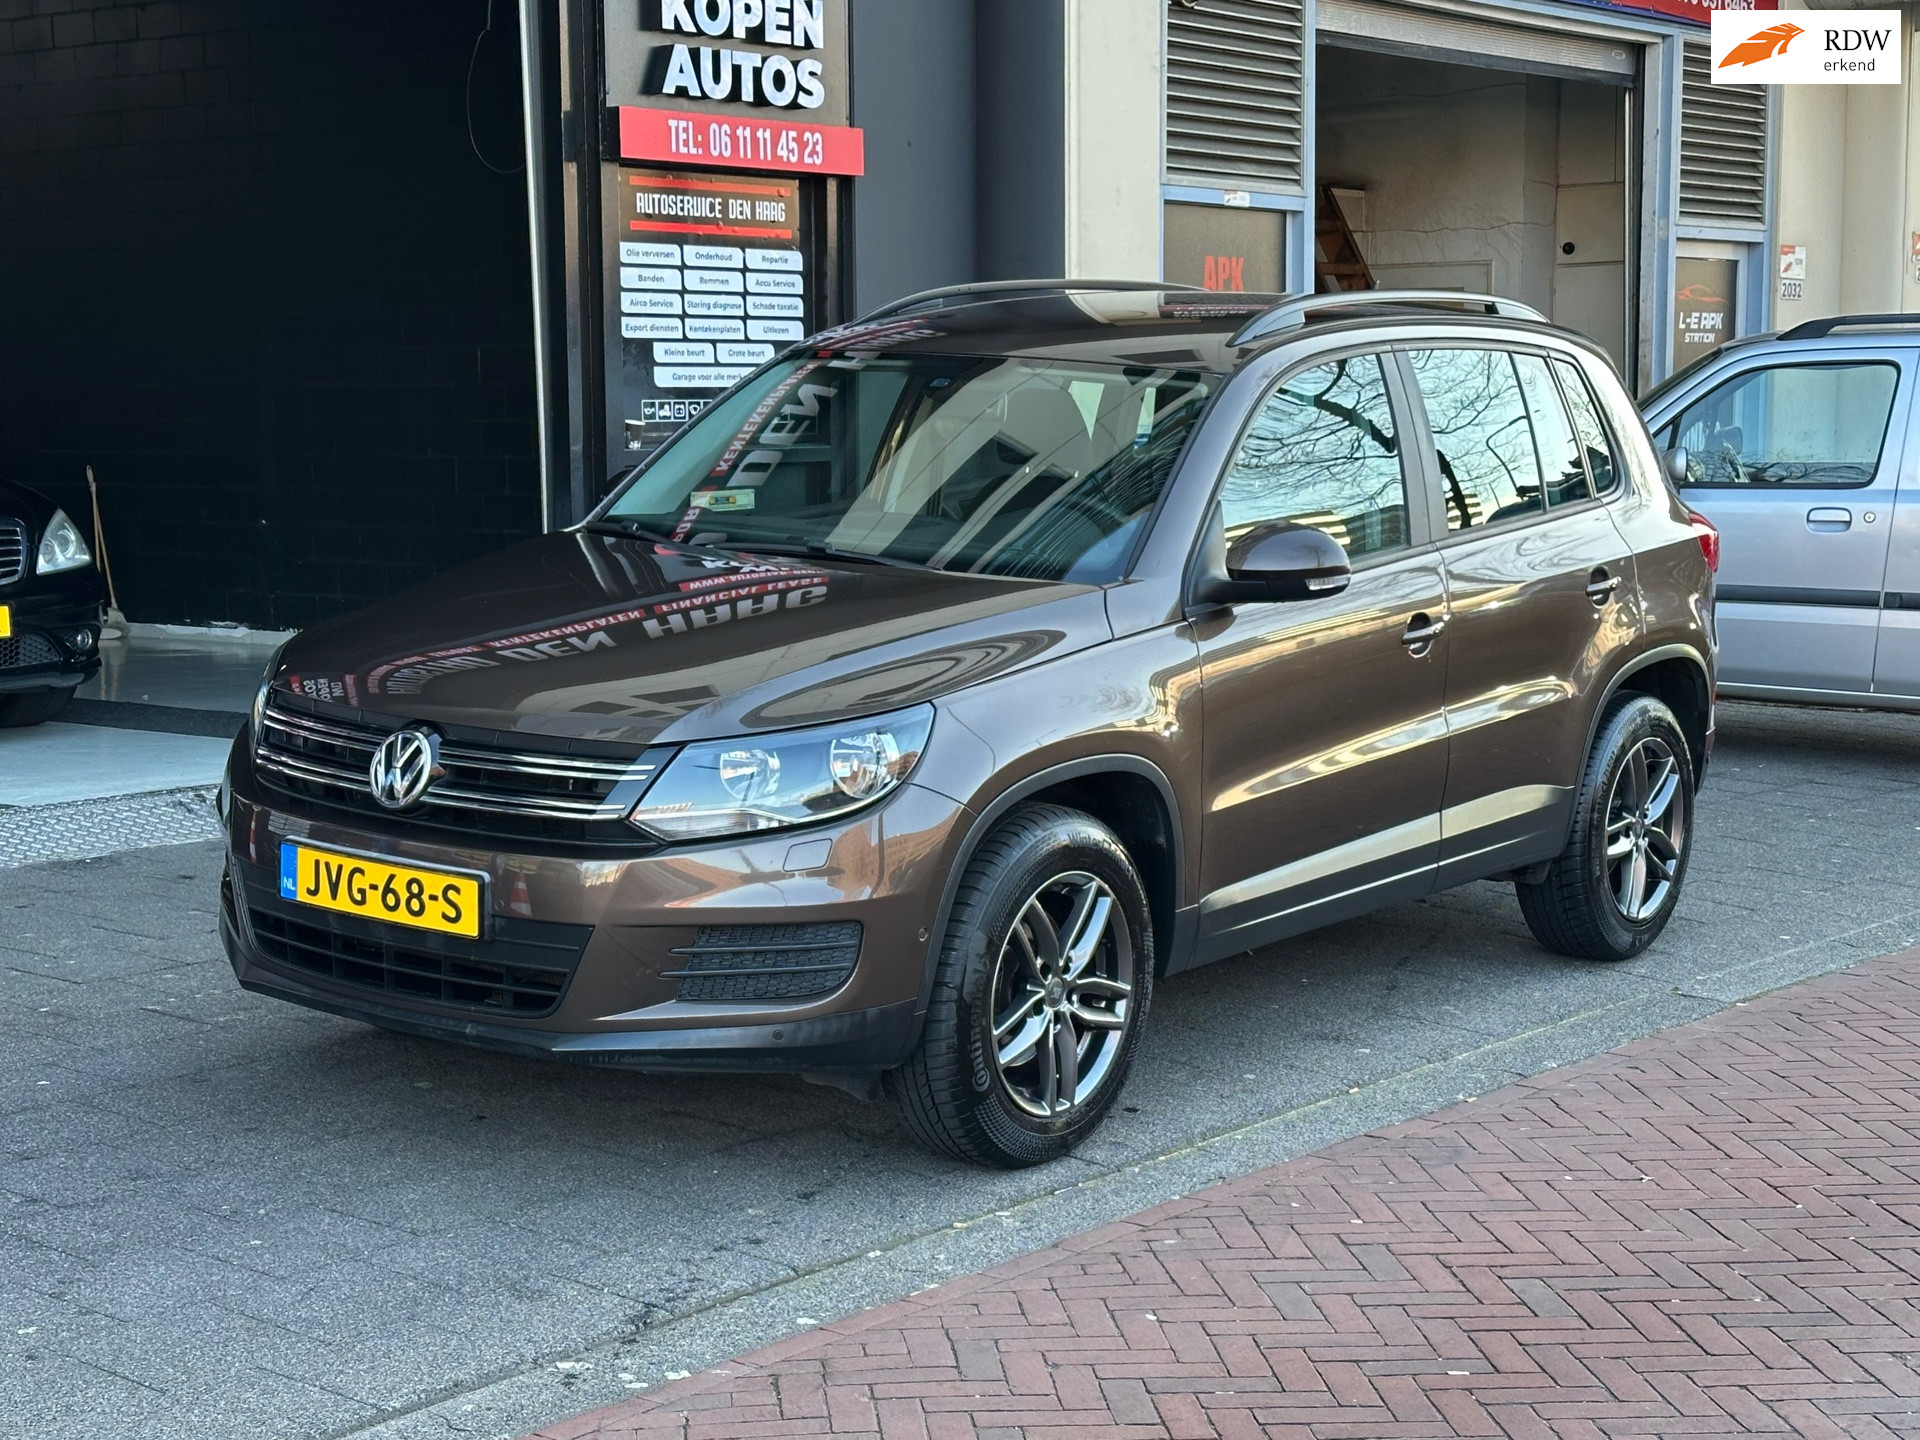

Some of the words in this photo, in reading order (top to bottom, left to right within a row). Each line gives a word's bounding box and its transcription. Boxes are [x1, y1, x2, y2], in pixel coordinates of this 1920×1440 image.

[662, 0, 824, 49] KOPEN
[662, 43, 825, 109] AUTOS
[667, 119, 703, 154] TEL:
[709, 122, 731, 158] 06
[736, 126, 752, 159] 11
[756, 128, 772, 161] 11
[777, 130, 798, 163] 45
[803, 131, 823, 165] 23
[728, 200, 751, 220] DEN
[755, 202, 786, 222] HAAG
[626, 248, 640, 258] Olie
[641, 250, 675, 259] verversen
[695, 251, 733, 262] Onderhoud
[1203, 254, 1244, 292] APK
[638, 274, 665, 284] Banden
[699, 276, 730, 286] Remmen
[755, 279, 771, 288] Accu
[772, 280, 796, 288] Service
[1781, 282, 1802, 299] 2032
[630, 299, 648, 308] Airco
[649, 299, 674, 309] Service
[687, 301, 711, 311] Storing
[712, 302, 742, 311] diagnose
[752, 302, 776, 311] Schade
[777, 303, 799, 311] taxatie
[1700, 312, 1724, 330] APK
[625, 324, 648, 334] Export
[649, 324, 679, 333] diensten
[688, 325, 741, 335] Kentekenplaten
[763, 326, 789, 335] Uitlezen
[1684, 333, 1715, 343] STATION
[664, 348, 686, 357] Kleine
[686, 348, 705, 357] beurt
[728, 348, 746, 357] Grote
[747, 348, 765, 357] beurt
[672, 372, 696, 382] Garage
[713, 372, 725, 381] alle
[283, 877, 296, 891] NL
[305, 858, 463, 924] JVG-68-S
